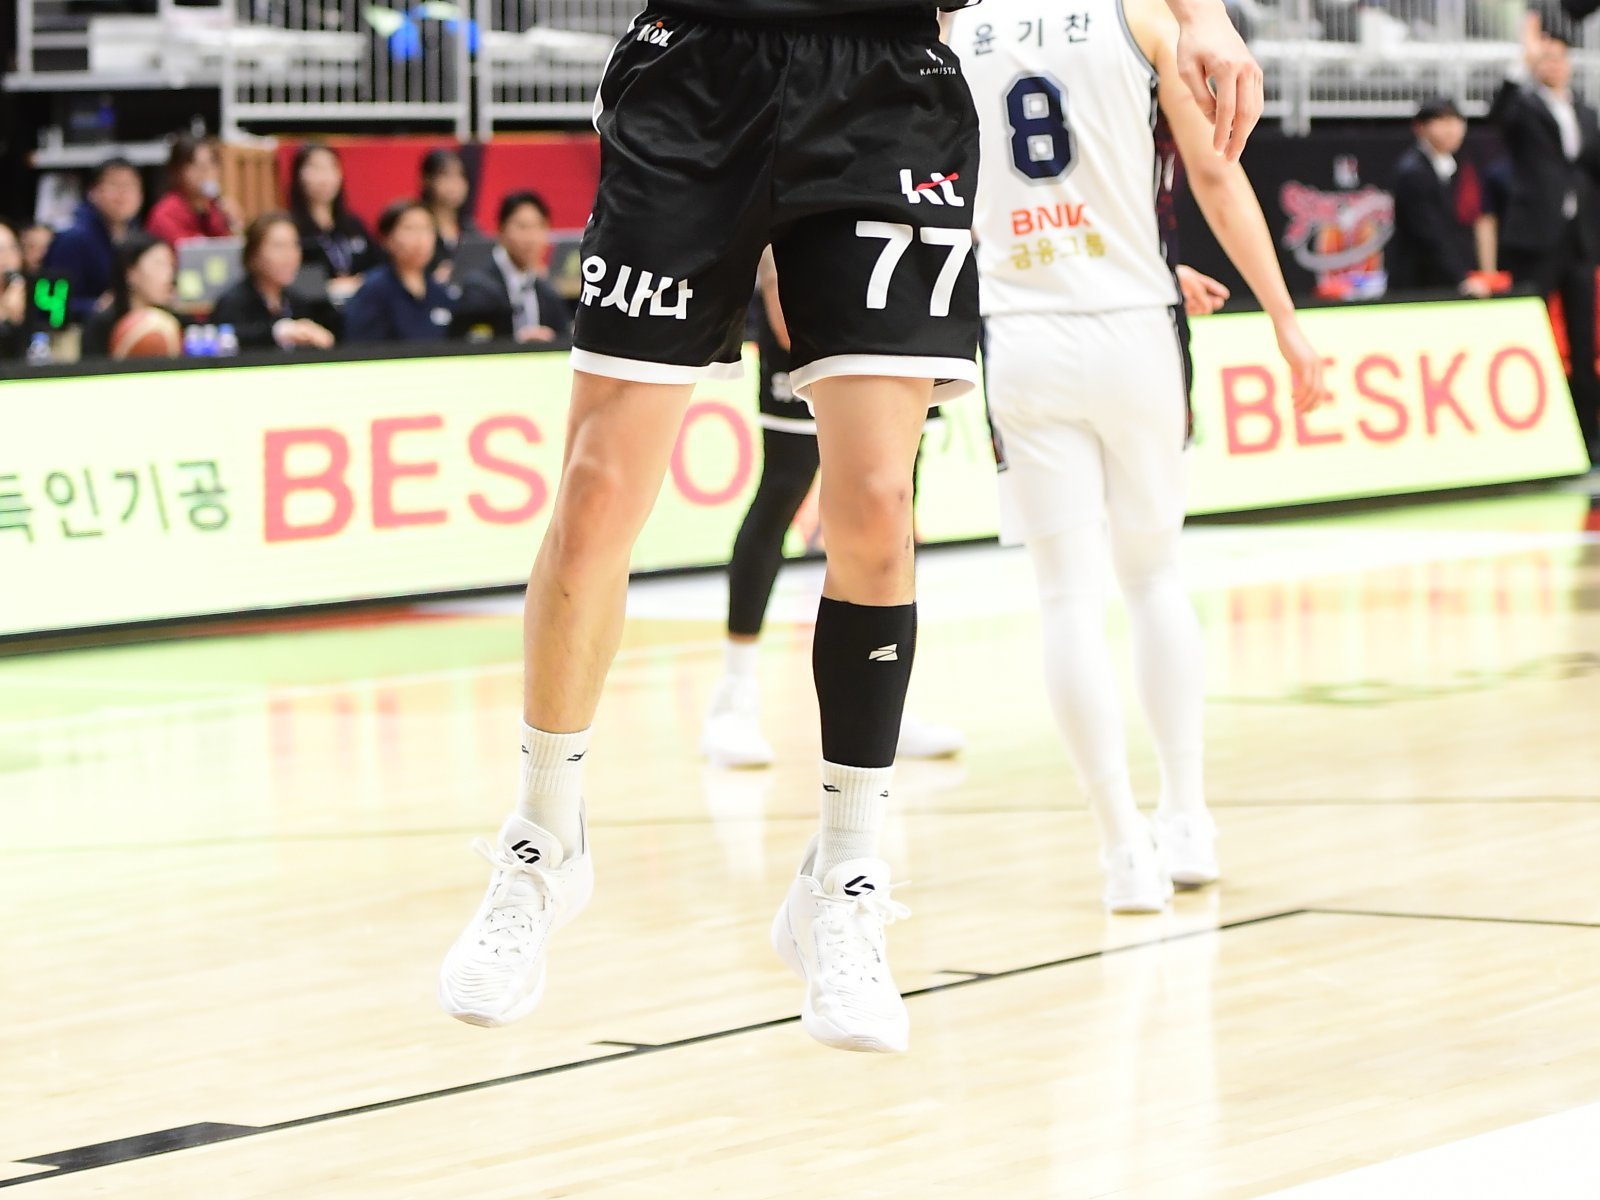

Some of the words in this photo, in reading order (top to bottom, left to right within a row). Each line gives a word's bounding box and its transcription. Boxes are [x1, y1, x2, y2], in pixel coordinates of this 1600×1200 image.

[919, 66, 957, 77] KAMISTA
[1003, 72, 1077, 186] 8
[900, 168, 965, 208] kt
[1011, 202, 1091, 237] BNK
[581, 255, 694, 320] 유사나
[855, 220, 973, 317] 77
[1221, 346, 1547, 455] BESKO
[263, 400, 755, 544] BESO
